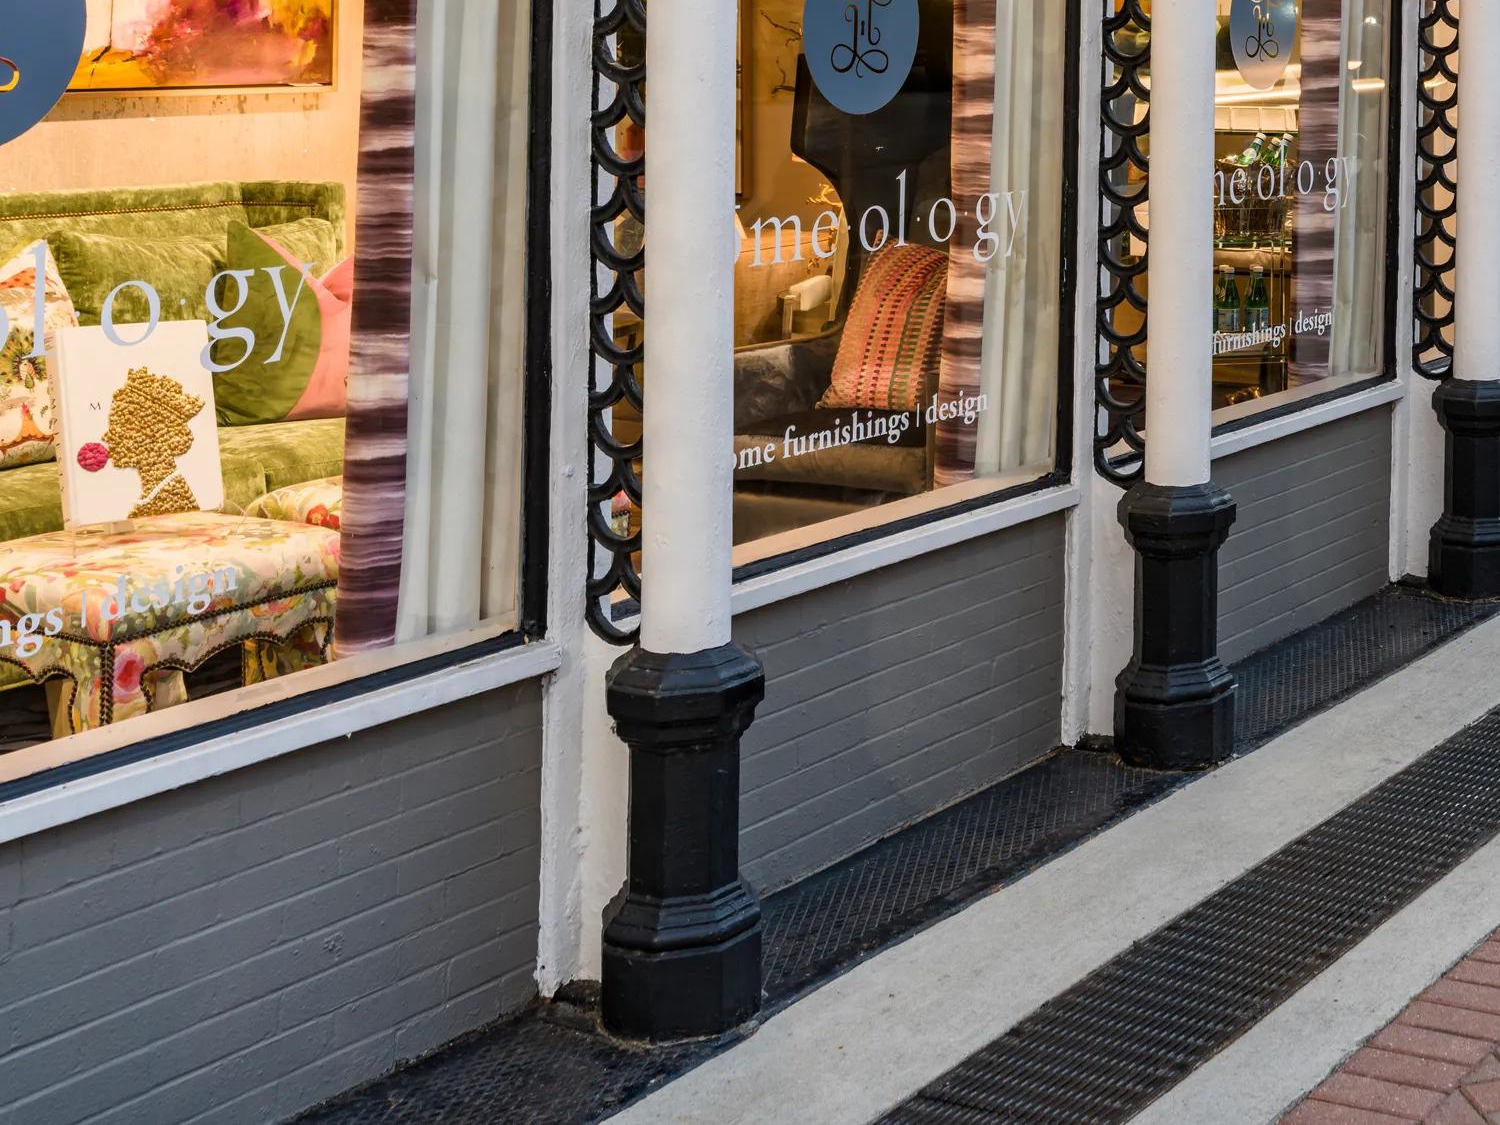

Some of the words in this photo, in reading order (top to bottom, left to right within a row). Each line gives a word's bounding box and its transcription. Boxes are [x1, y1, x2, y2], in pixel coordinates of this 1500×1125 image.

[1212, 321, 1286, 355] furnishings
[1294, 309, 1333, 336] design
[782, 410, 910, 460] furnishings
[925, 390, 989, 425] design
[102, 565, 239, 620] design
